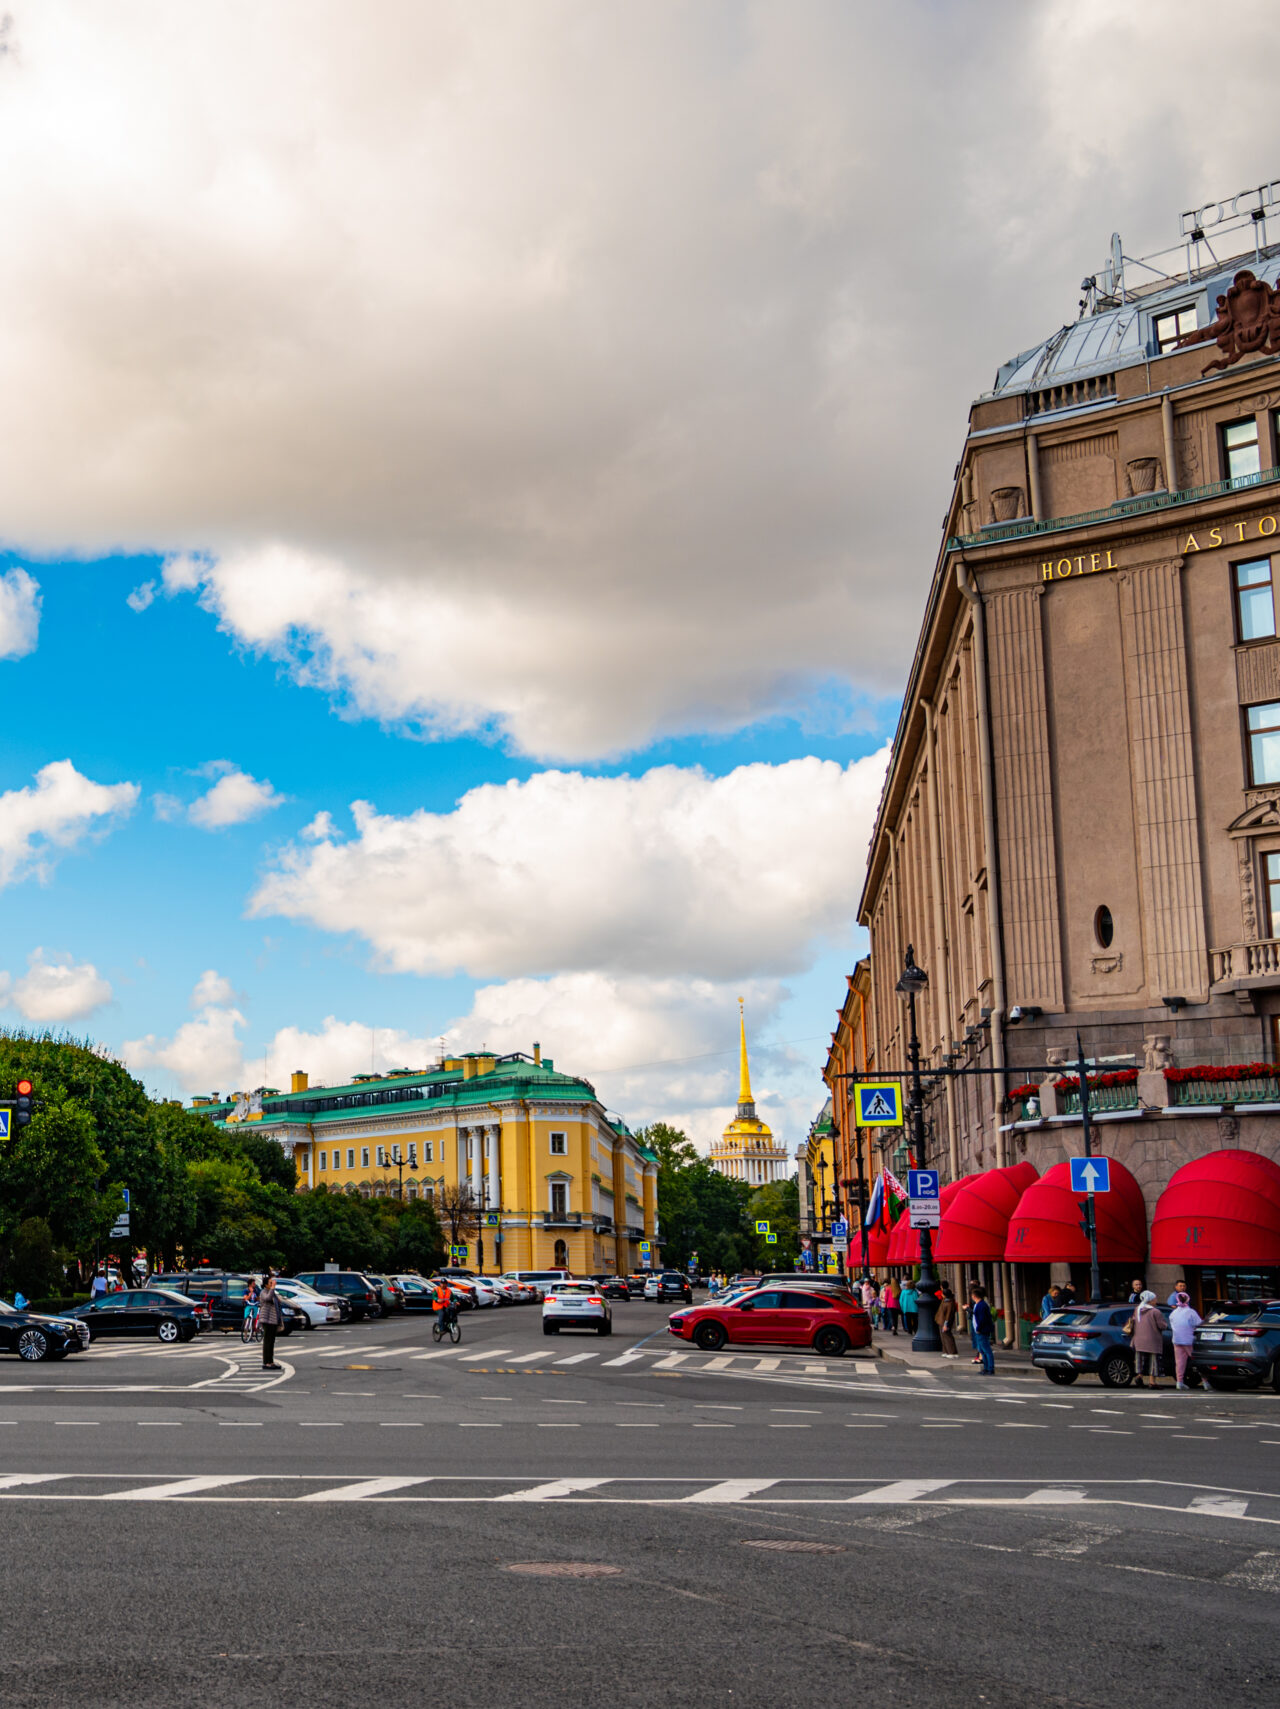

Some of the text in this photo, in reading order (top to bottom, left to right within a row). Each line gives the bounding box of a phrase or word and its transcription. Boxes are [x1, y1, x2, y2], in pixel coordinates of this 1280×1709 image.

[1042, 516, 1277, 580] HOTEL ASTO
[917, 1173, 933, 1195] P
